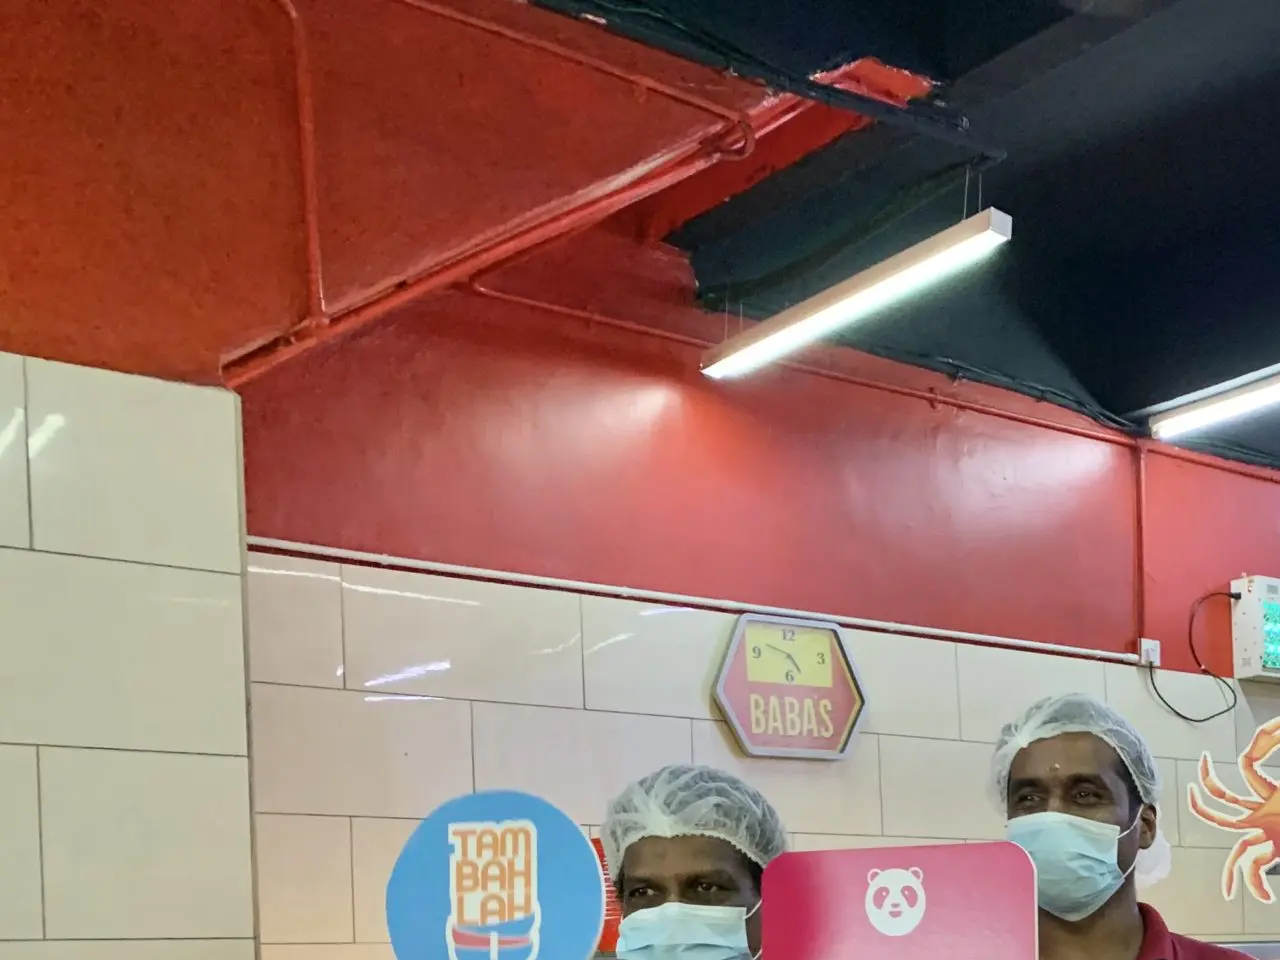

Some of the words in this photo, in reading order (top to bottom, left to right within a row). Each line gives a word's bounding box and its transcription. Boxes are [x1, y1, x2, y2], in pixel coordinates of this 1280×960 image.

[782, 630, 796, 642] 12
[752, 646, 762, 659] 9
[816, 652, 826, 666] 3
[785, 670, 794, 683] 6
[452, 827, 531, 858] TAM
[455, 859, 531, 892] BAH
[457, 893, 531, 925] LAH
